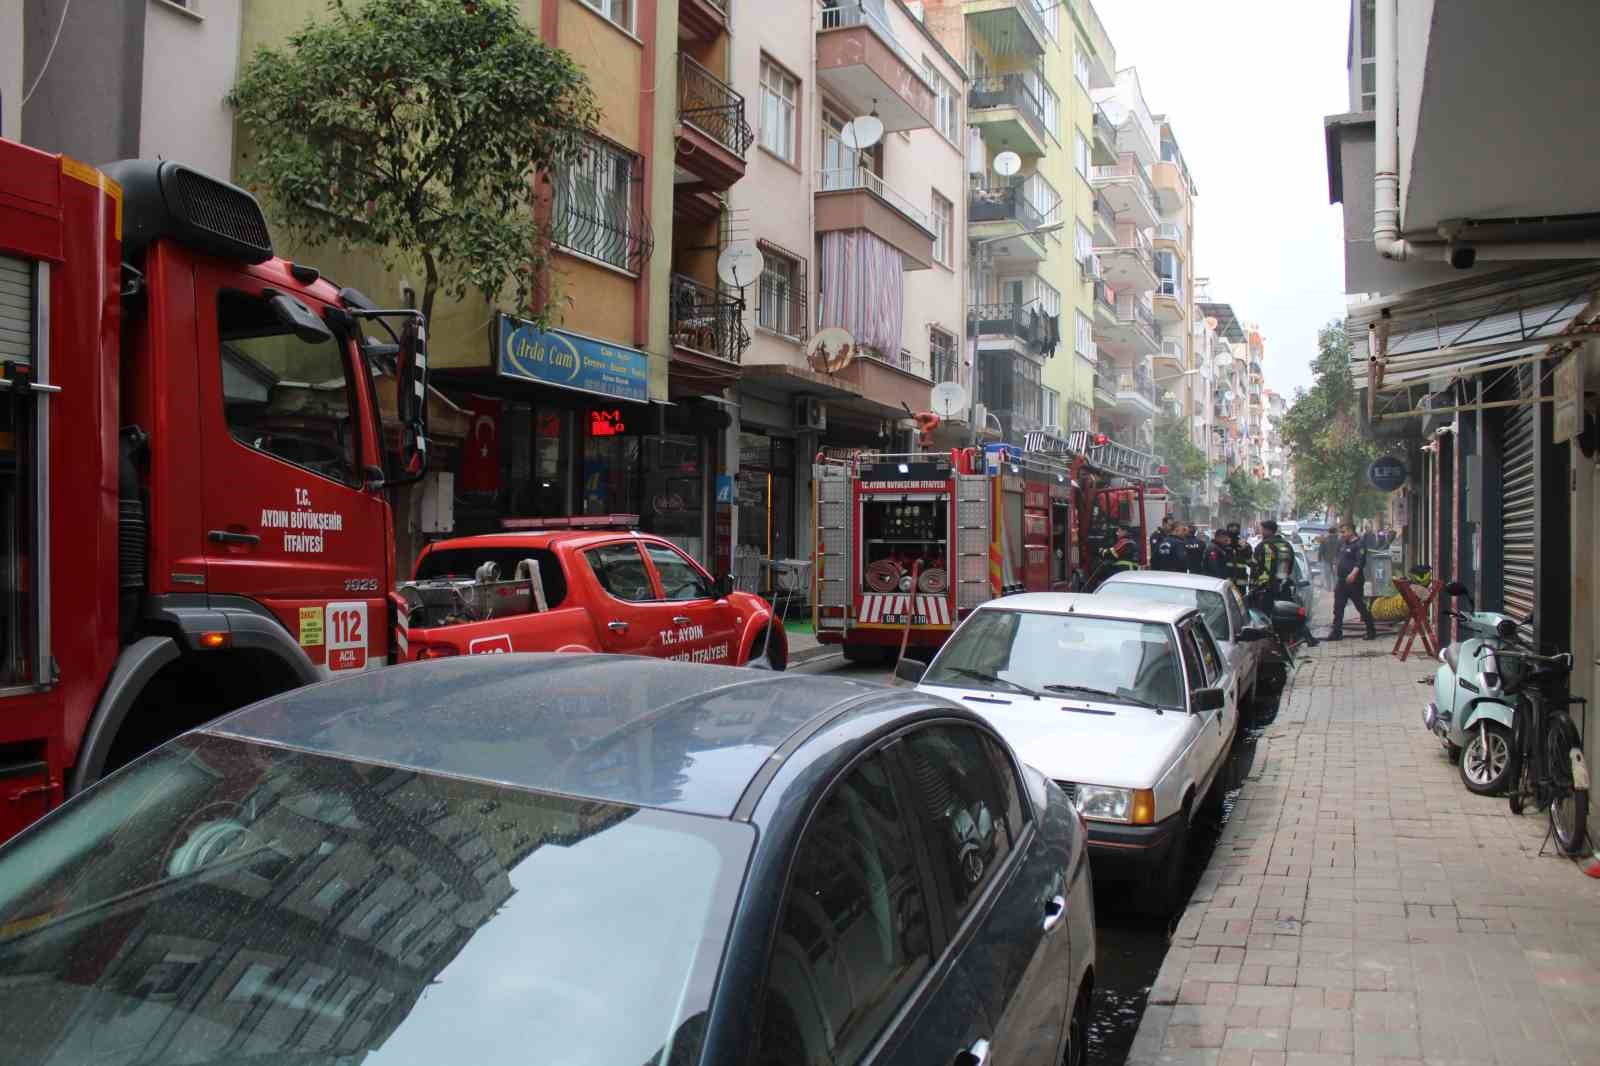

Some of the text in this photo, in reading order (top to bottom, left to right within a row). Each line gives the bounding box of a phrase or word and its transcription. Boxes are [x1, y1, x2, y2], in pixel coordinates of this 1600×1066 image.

[295, 487, 311, 506] T.C.
[261, 509, 342, 531] AYDIN BÜYÜKŞEHİR
[284, 529, 323, 553] İTFAİYESİ
[332, 610, 362, 644] 112
[659, 625, 704, 646] T.C. AYDIN
[692, 640, 728, 664] İTFAİYESİ
